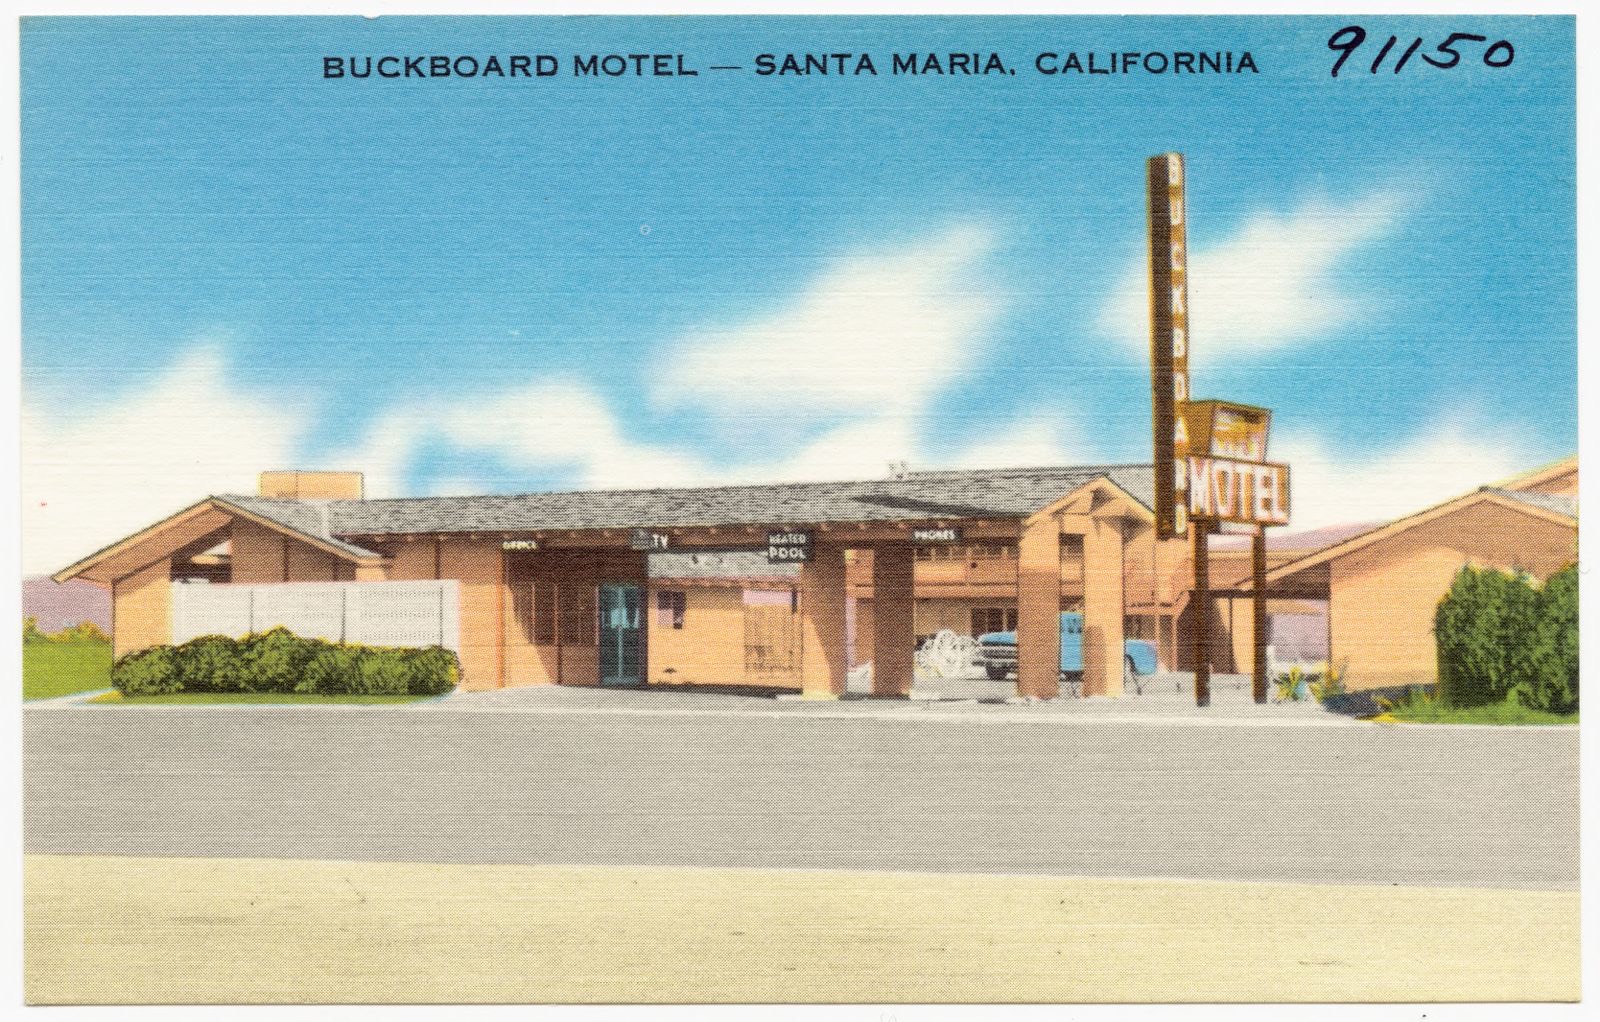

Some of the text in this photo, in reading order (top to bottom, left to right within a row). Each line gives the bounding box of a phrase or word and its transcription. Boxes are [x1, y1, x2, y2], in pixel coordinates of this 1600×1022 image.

[1327, 25, 1515, 78] 91150
[1167, 152, 1190, 534] BUCKBOARD
[1189, 457, 1288, 523] MOTEL
[652, 533, 669, 549] TV
[769, 546, 807, 560] POOL
